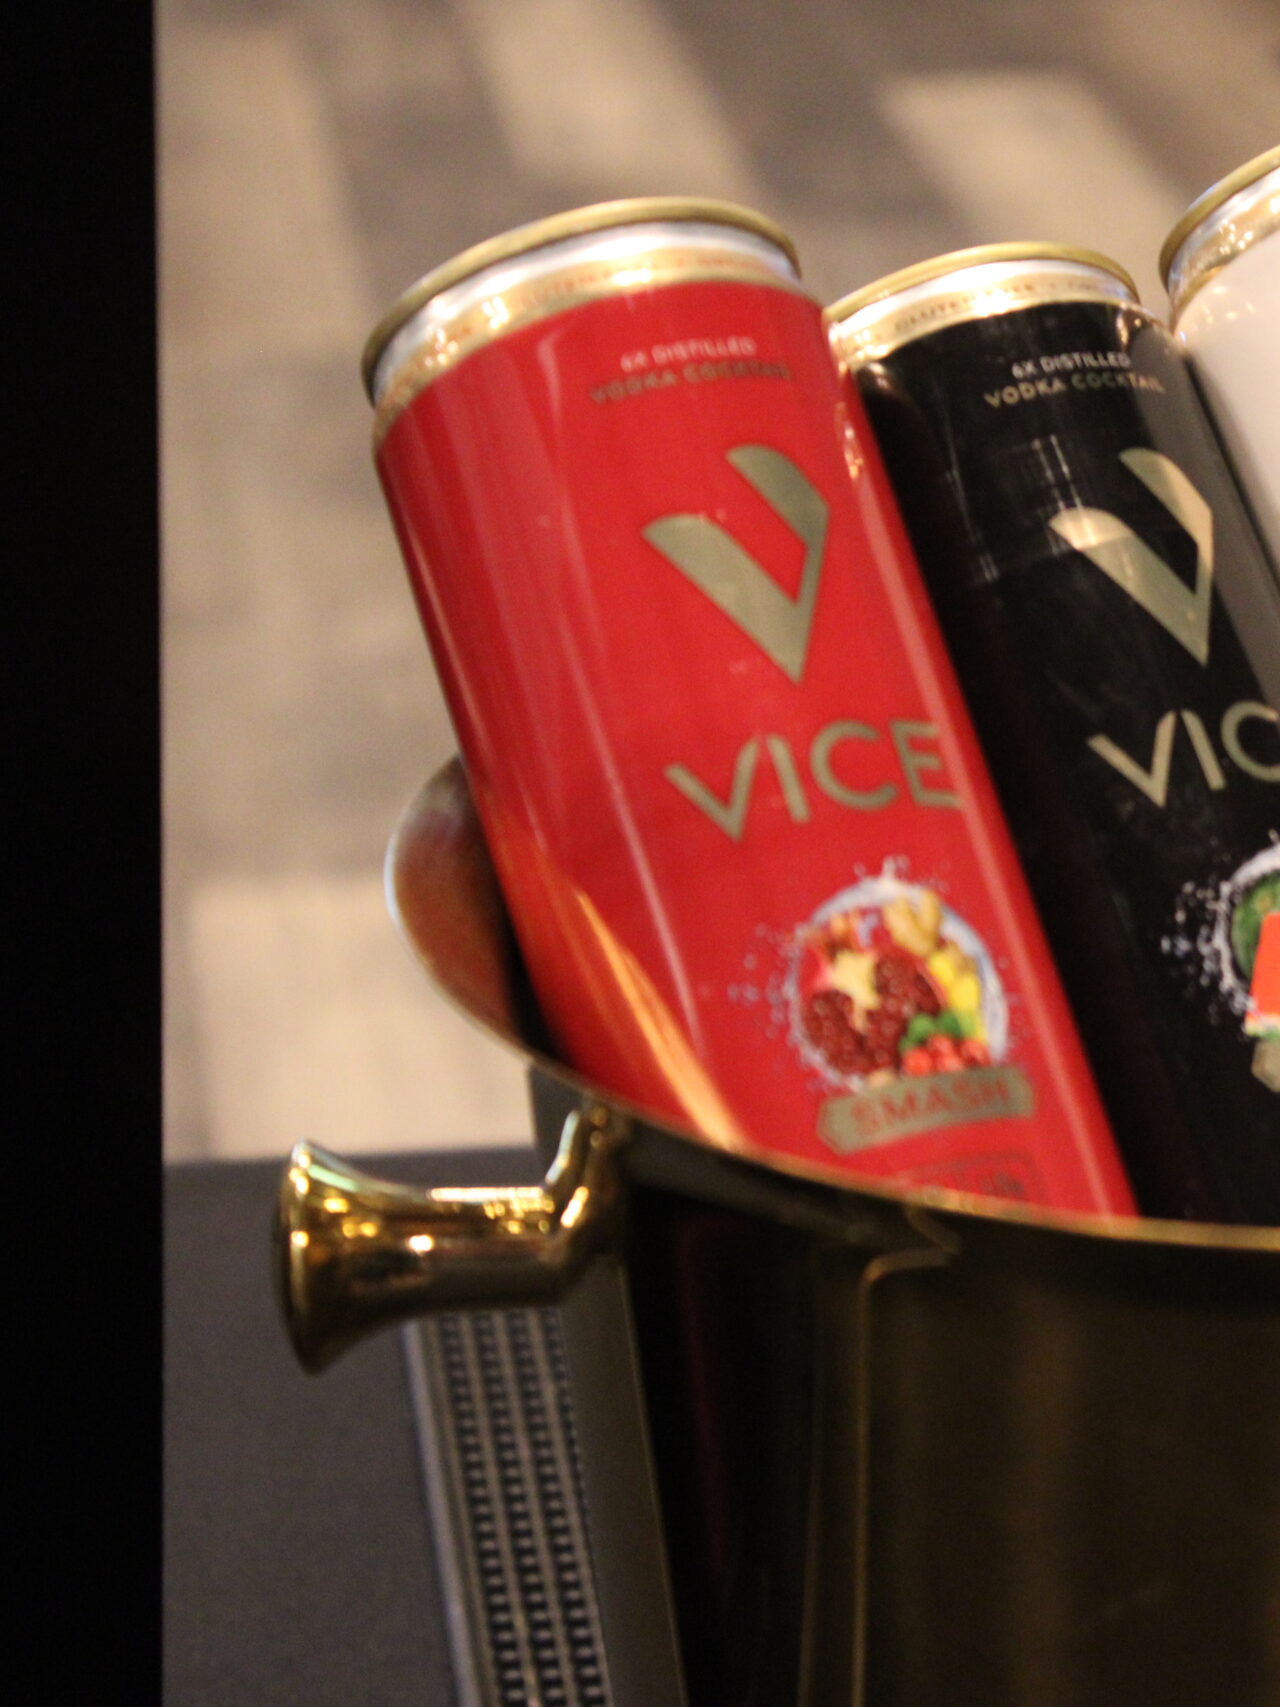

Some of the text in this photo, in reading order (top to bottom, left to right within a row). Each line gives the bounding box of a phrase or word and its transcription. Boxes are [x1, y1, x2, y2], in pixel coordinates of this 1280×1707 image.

[651, 336, 757, 365] DISTILLED
[1012, 352, 1131, 378] 6X DISTILLED
[590, 370, 678, 404] VODKA
[984, 371, 1166, 408] VODKA COCKTAIL
[663, 719, 966, 843] VICE
[851, 1077, 1012, 1135] SMASH
